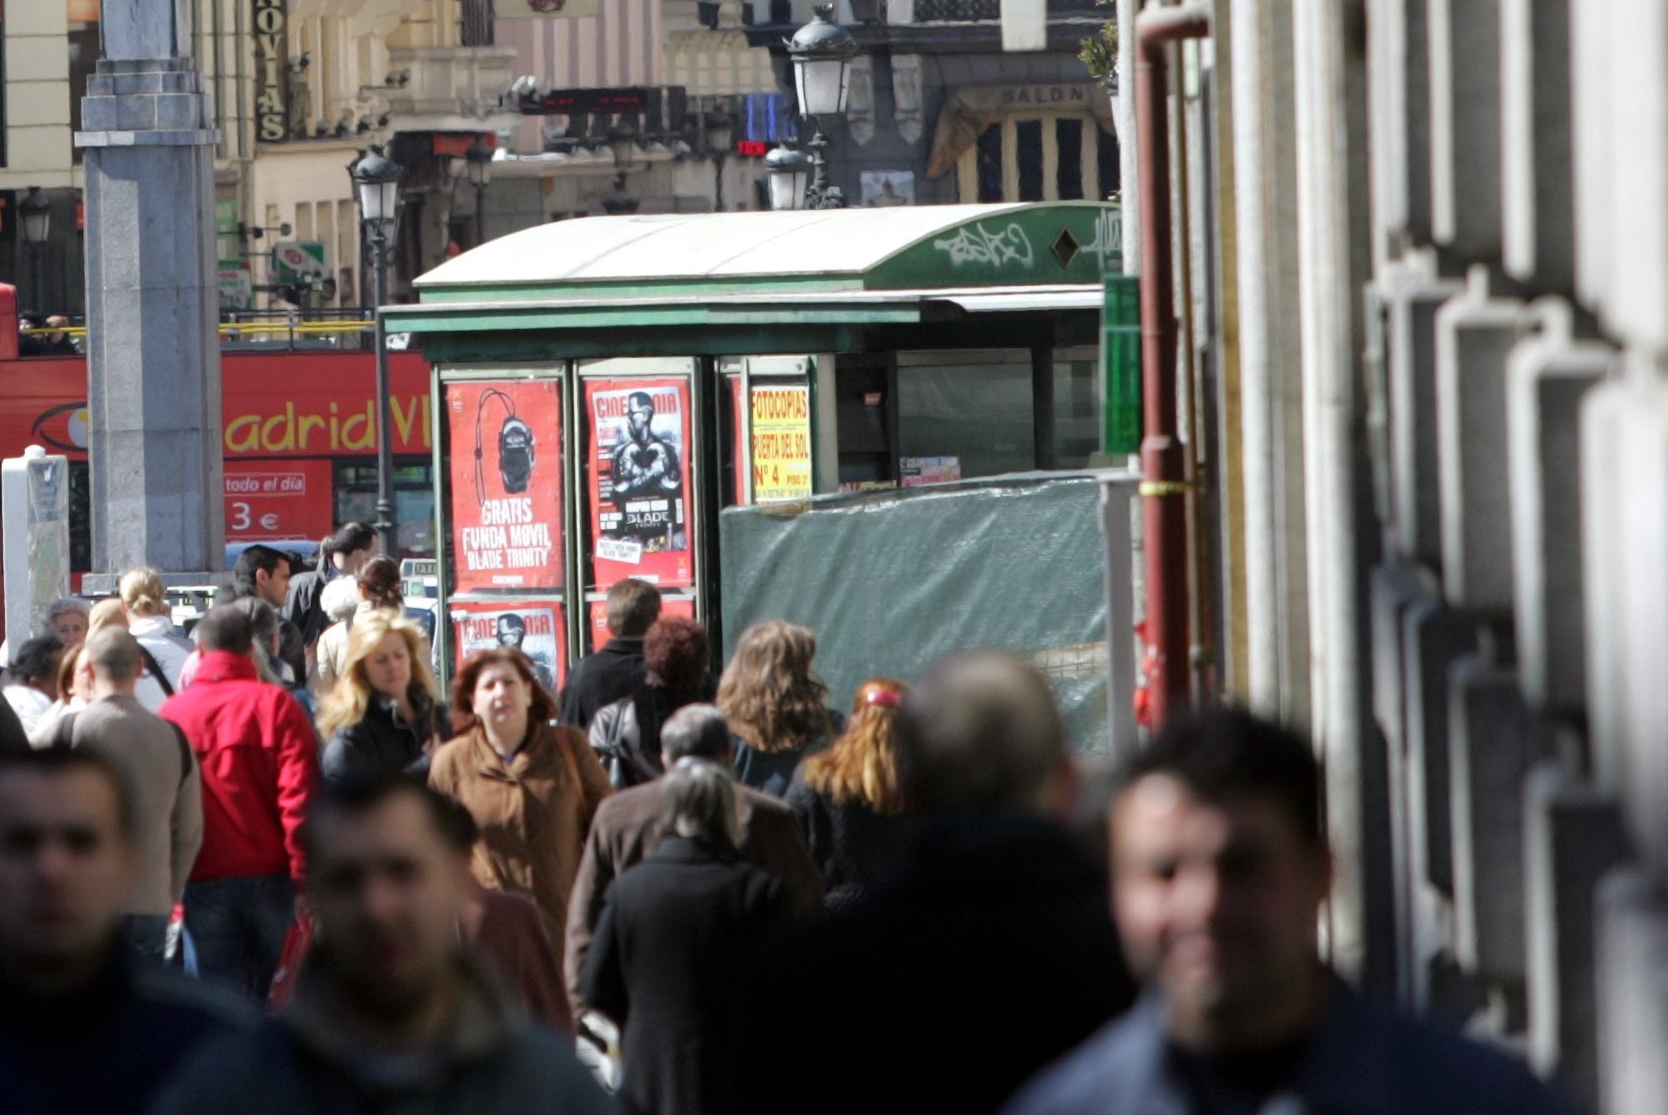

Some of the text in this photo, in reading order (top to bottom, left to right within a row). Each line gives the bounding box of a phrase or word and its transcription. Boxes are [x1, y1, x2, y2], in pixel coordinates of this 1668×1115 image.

[596, 392, 677, 418] CINENIA
[750, 390, 807, 419] FOTOCOPIAS
[224, 397, 375, 452] adrid
[753, 433, 809, 460] PUERTA DEL SOL
[225, 477, 260, 492] todo
[263, 476, 278, 492] el
[772, 464, 780, 486] 4
[231, 502, 279, 531] 3 €
[482, 498, 532, 525] GRATIS
[462, 527, 506, 551] FUNDA
